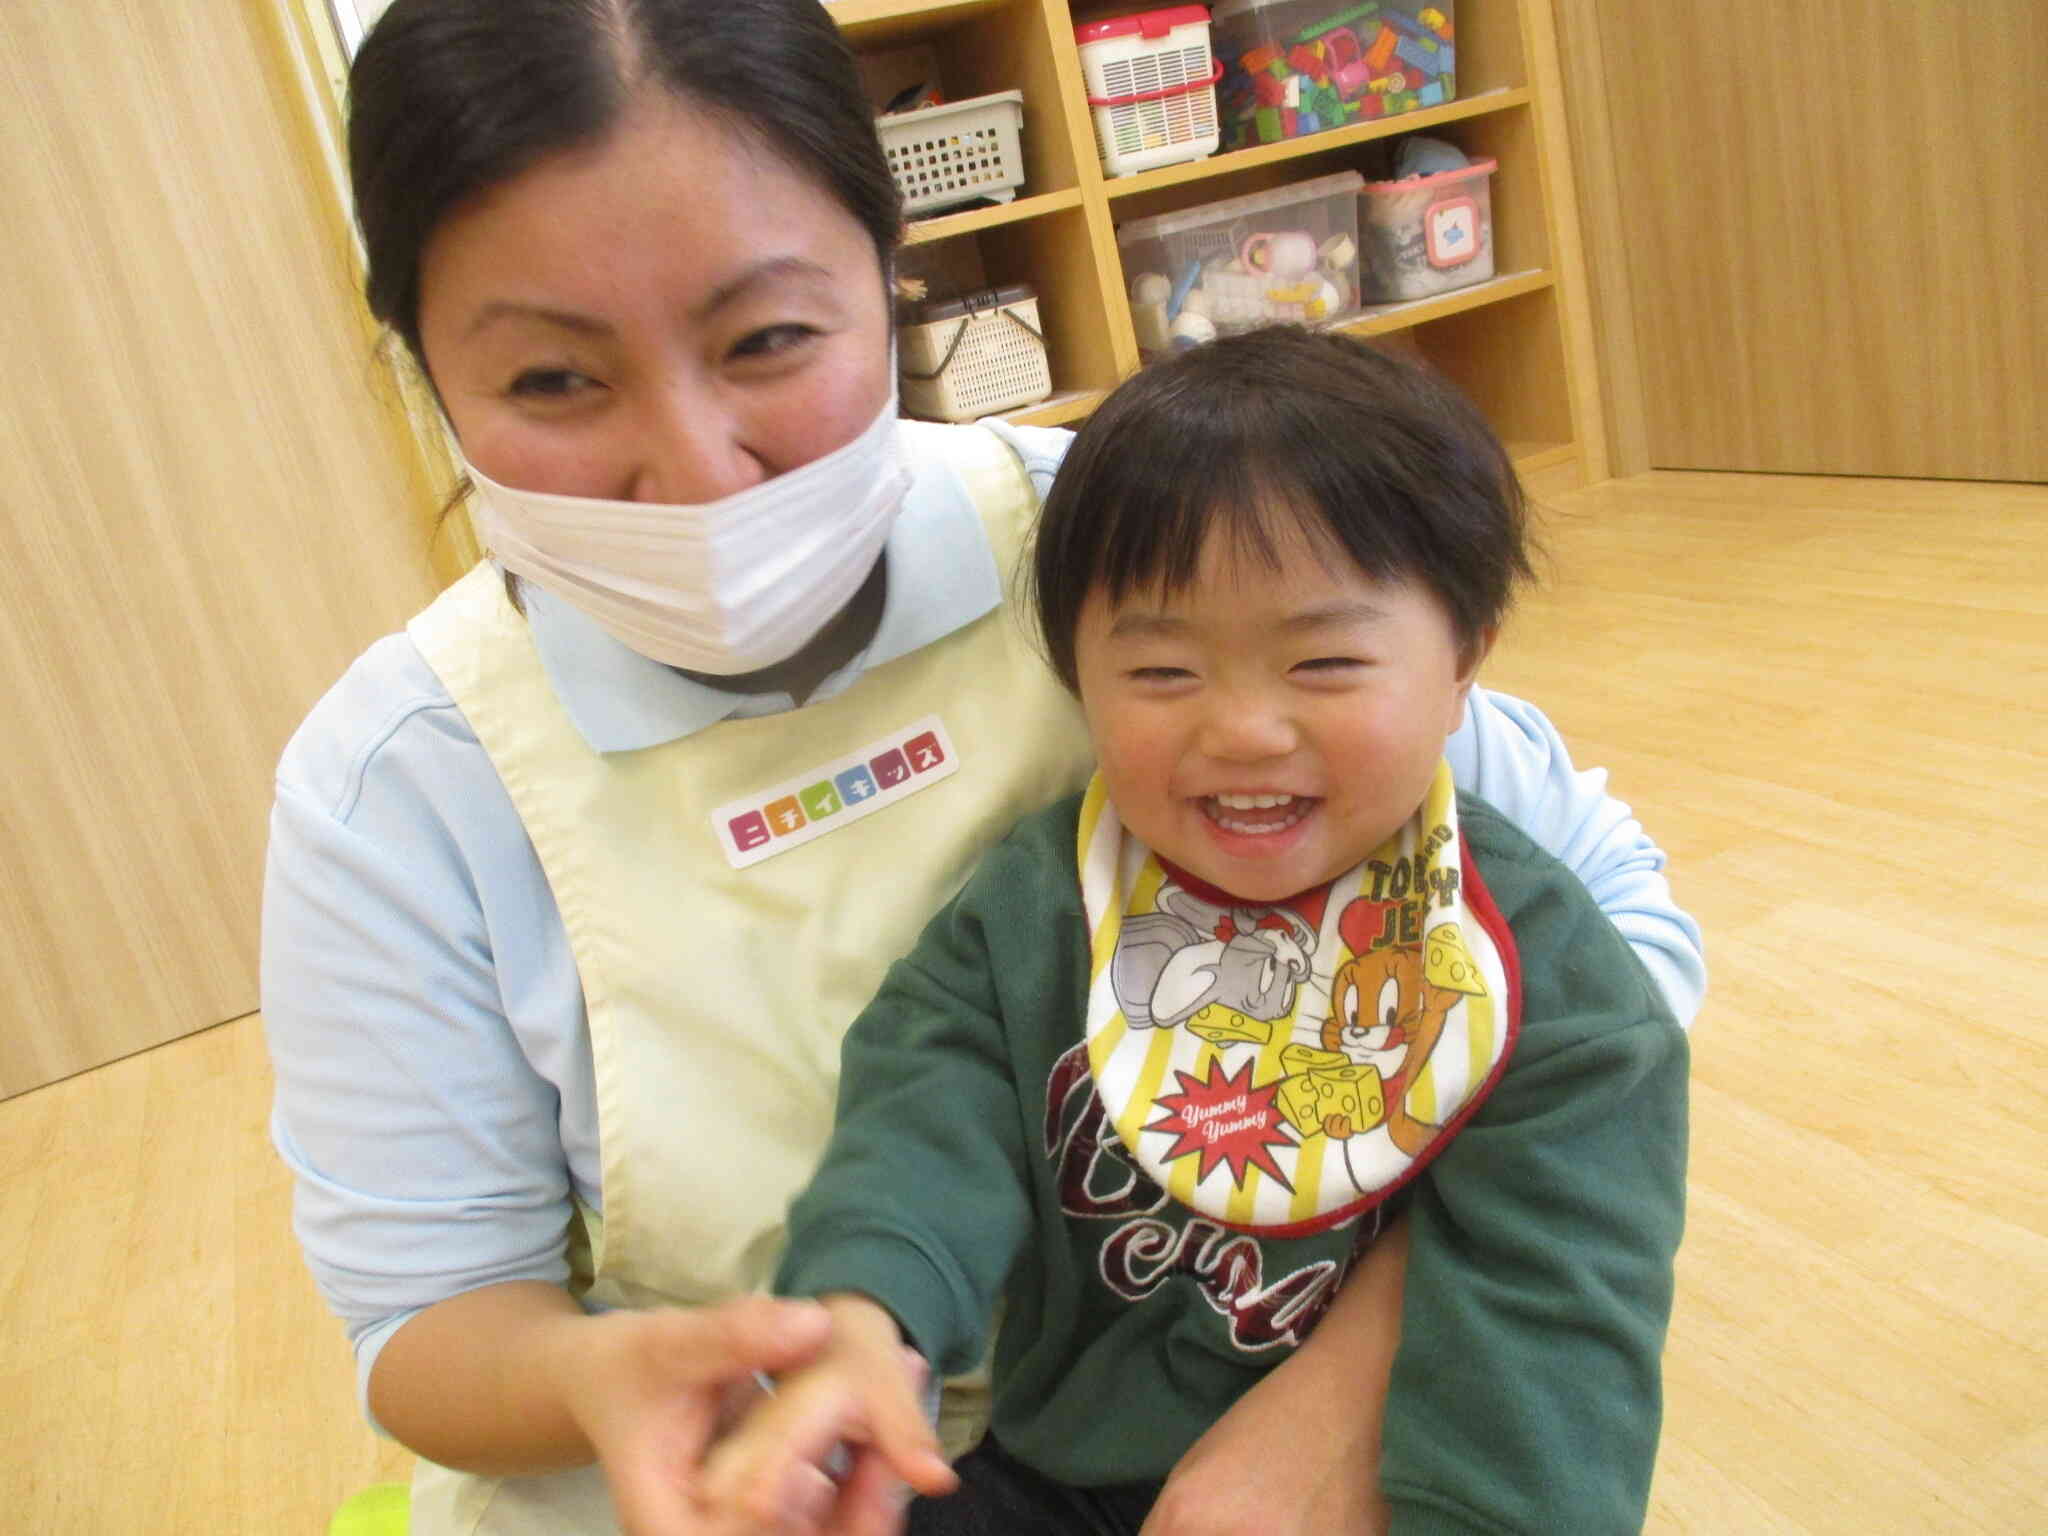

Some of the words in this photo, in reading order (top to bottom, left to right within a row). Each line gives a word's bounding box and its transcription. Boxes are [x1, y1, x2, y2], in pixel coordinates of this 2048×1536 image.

[740, 737, 941, 849] ニチイキッズ
[1181, 1096, 1247, 1128] Yummy
[1202, 1110, 1267, 1144] Yummy
